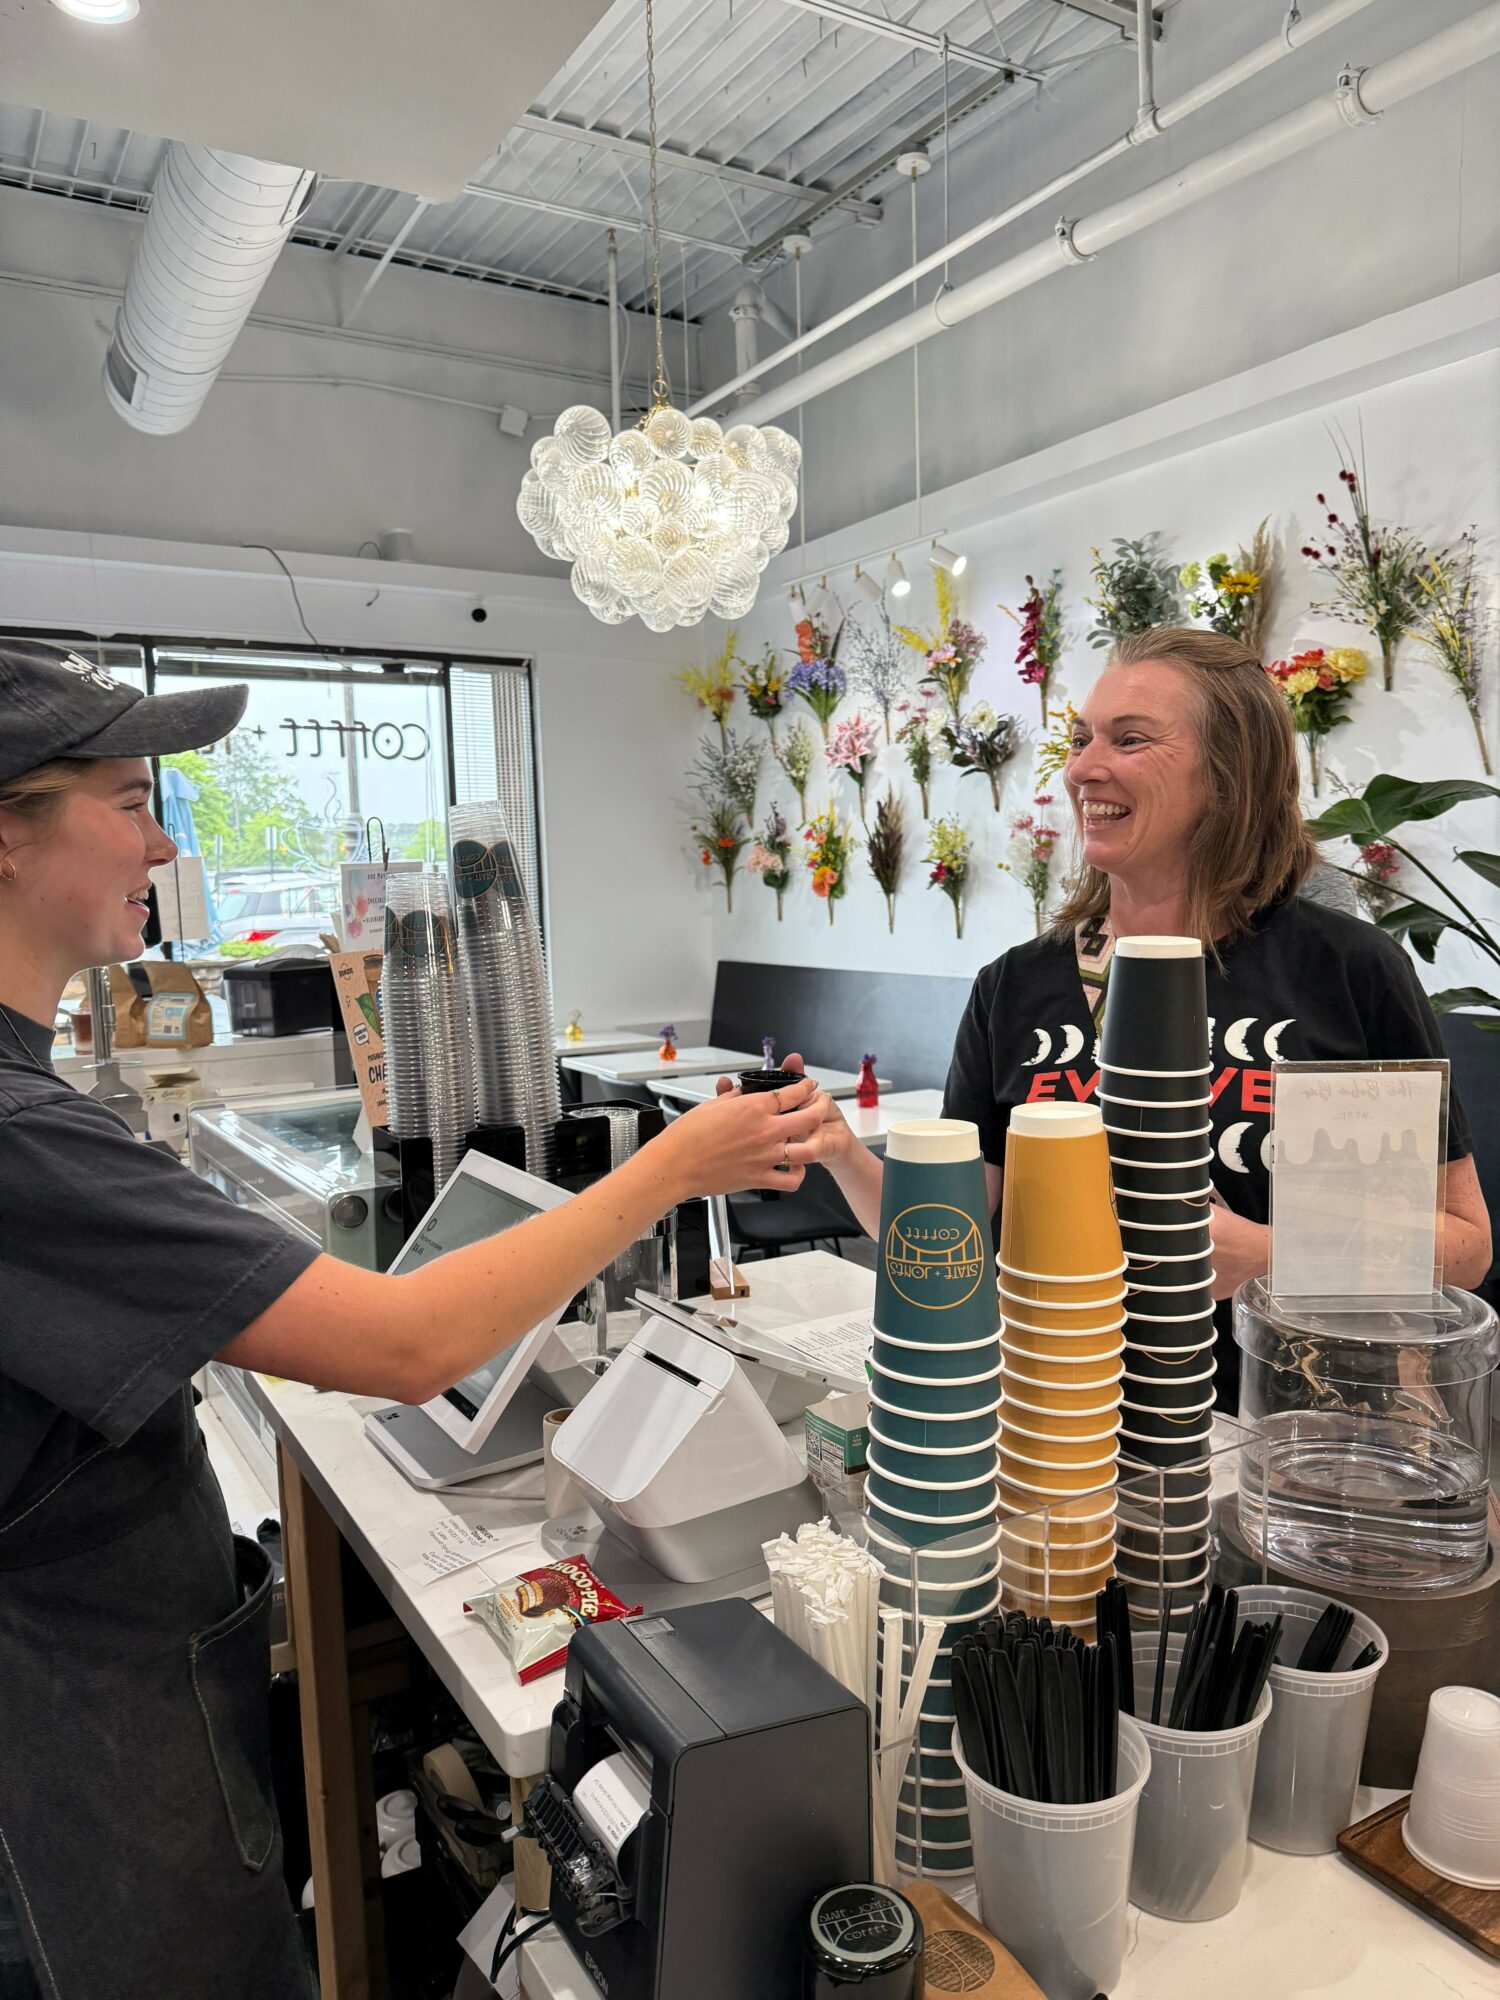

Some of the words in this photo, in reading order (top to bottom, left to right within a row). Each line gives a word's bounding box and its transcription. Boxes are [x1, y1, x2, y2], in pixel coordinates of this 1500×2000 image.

[1025, 1066, 1277, 1114] EVVE
[905, 1226, 960, 1241] COFFEE
[889, 1261, 933, 1279] JONES
[943, 1262, 979, 1280] STATE
